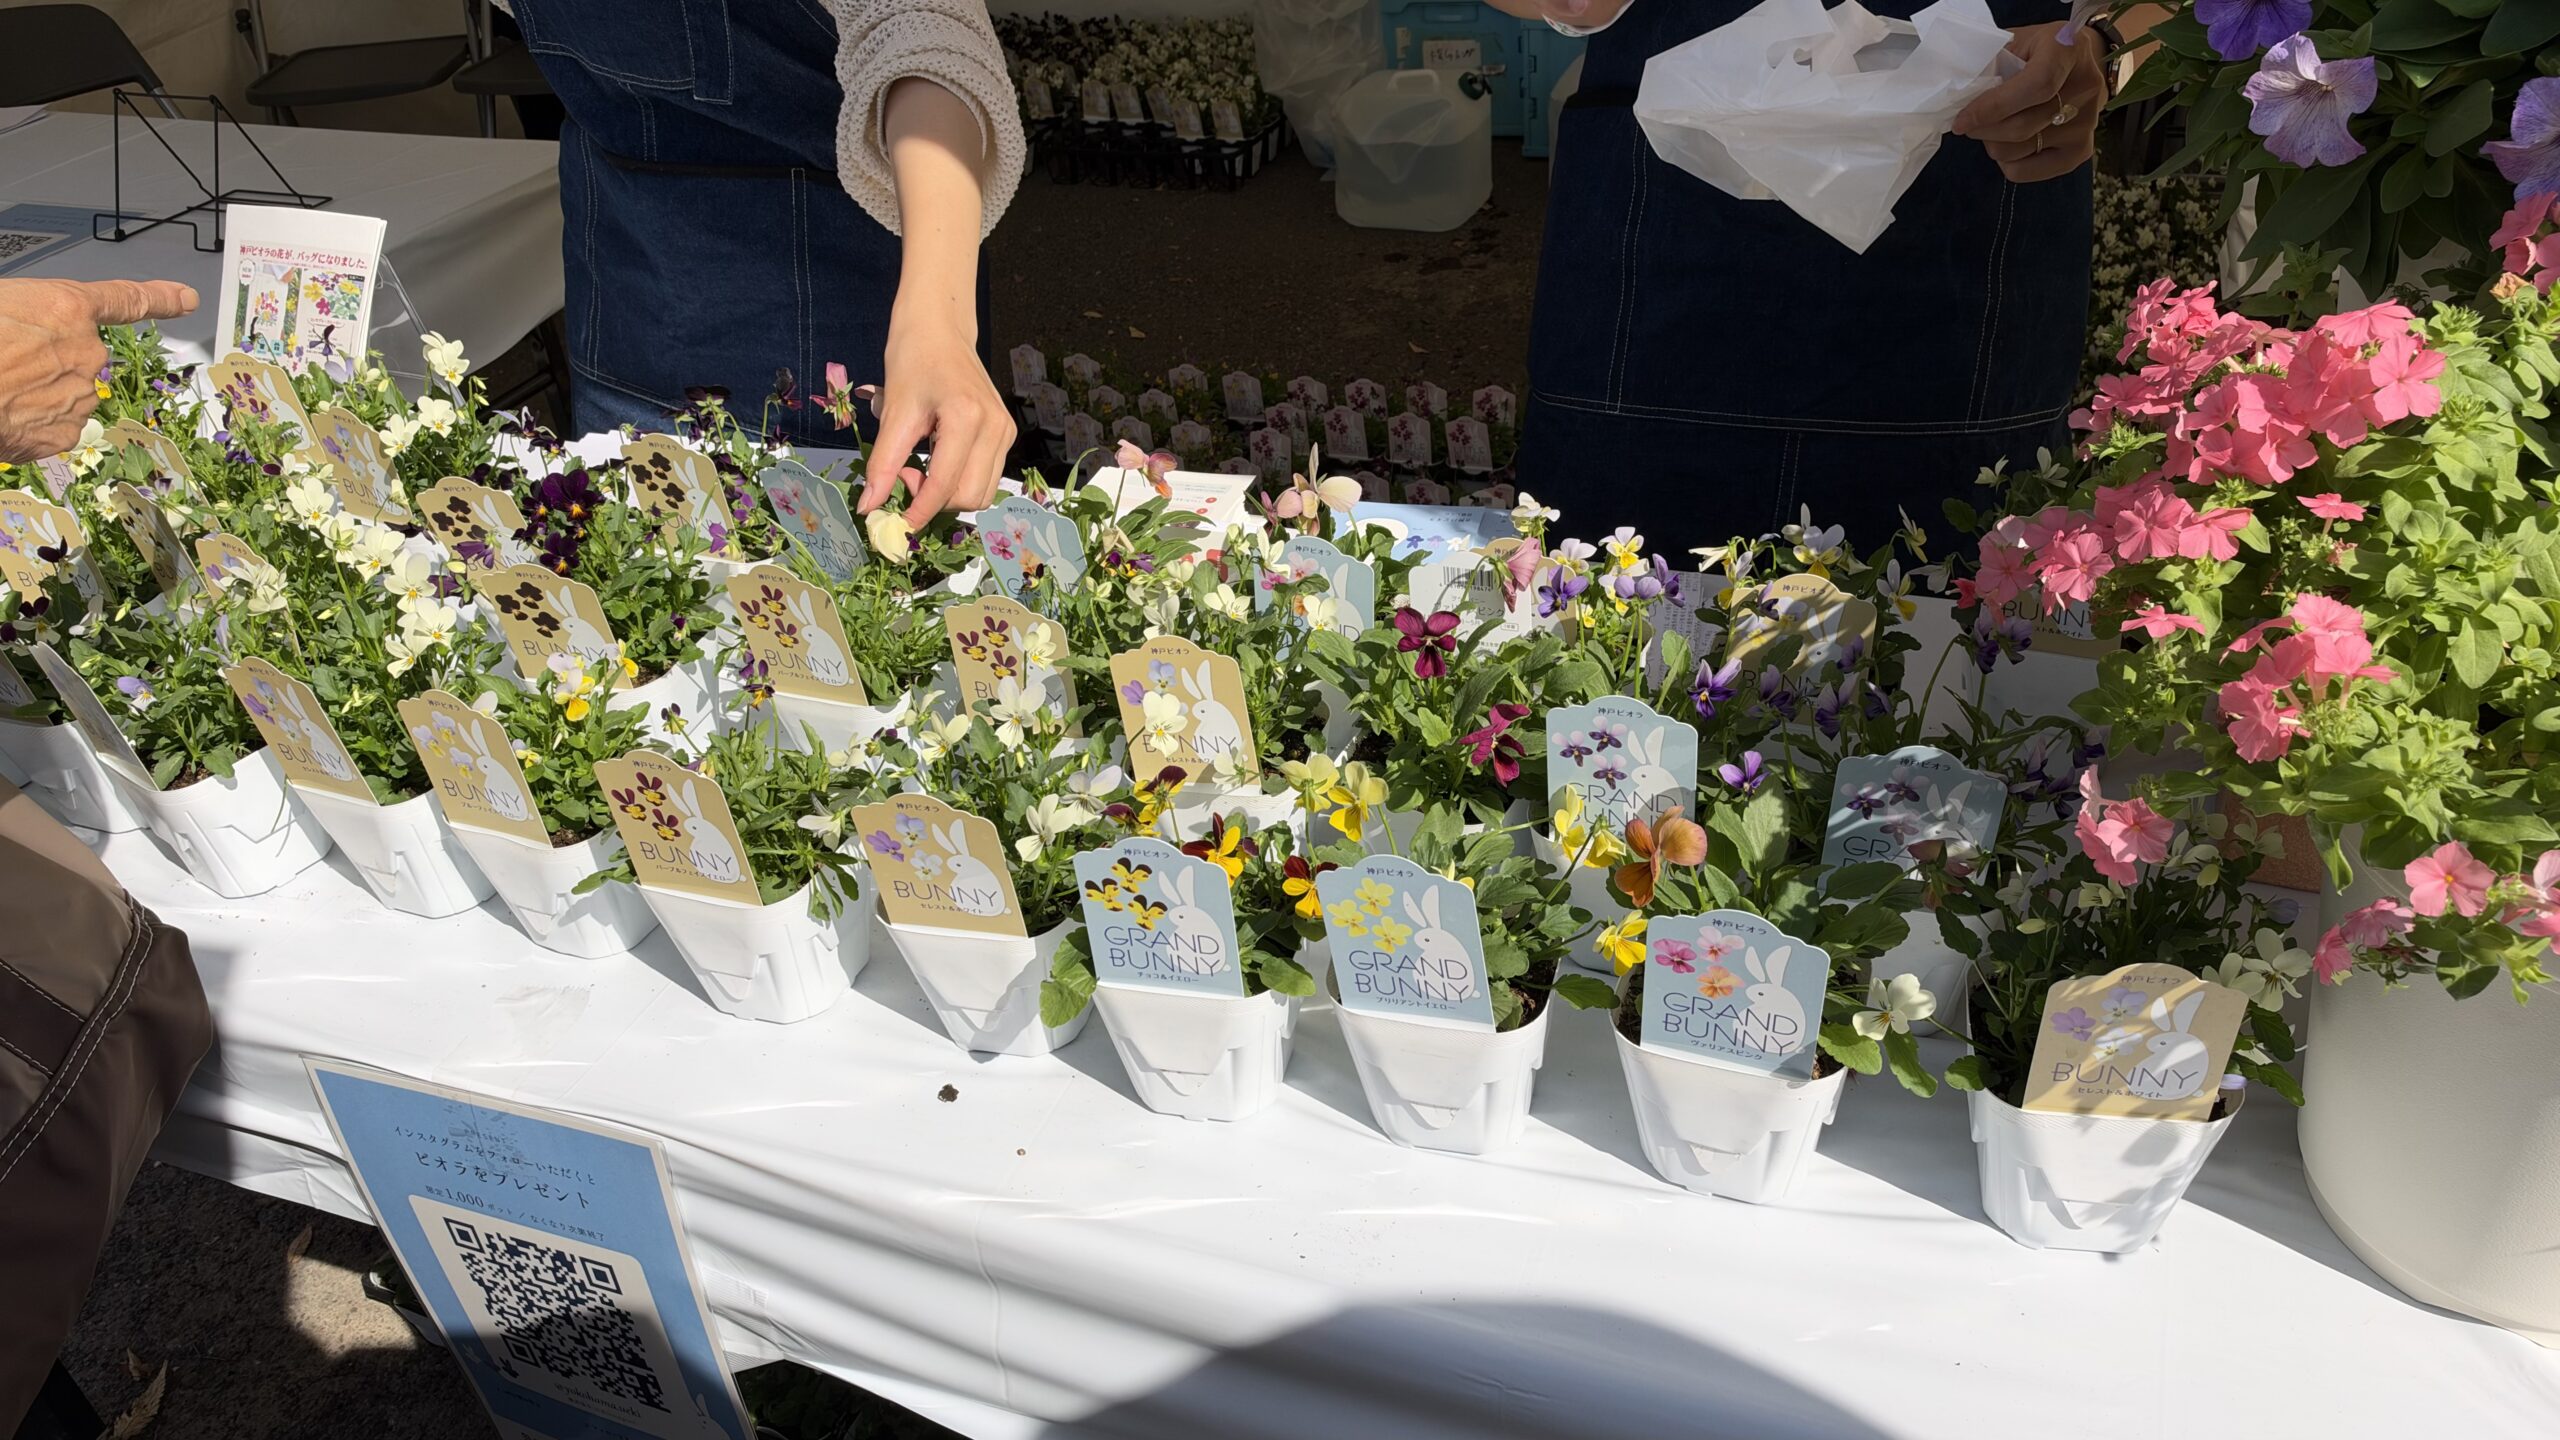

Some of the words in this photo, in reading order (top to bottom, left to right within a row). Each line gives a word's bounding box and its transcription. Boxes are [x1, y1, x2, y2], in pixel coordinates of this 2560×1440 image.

[764, 648, 842, 676] BUNNY
[1597, 706, 1644, 718] 神戸ビオラ
[277, 742, 343, 772] BUNNY
[442, 778, 520, 811] BUNNY
[896, 802, 940, 812] 神戸ビオラ
[640, 841, 732, 873] BUNNY
[1123, 847, 1171, 859] 神戸ビオラ
[1366, 867, 1415, 878] 神戸ビオラ
[893, 880, 998, 907] BUNNY
[1104, 926, 1220, 954] GRAND
[1712, 918, 1768, 935] 神戸ビオラ
[1109, 948, 1220, 977] BUNNY
[1349, 950, 1468, 980] GRAND
[1355, 973, 1469, 1003] BUNNY
[2121, 974, 2182, 985] 神戸ビオラ
[1663, 992, 1798, 1036] GRAND
[1662, 1013, 1795, 1057] BUNNY
[1691, 1039, 1763, 1060] ヴァリアスピンク
[2051, 1062, 2199, 1090] BUNNY
